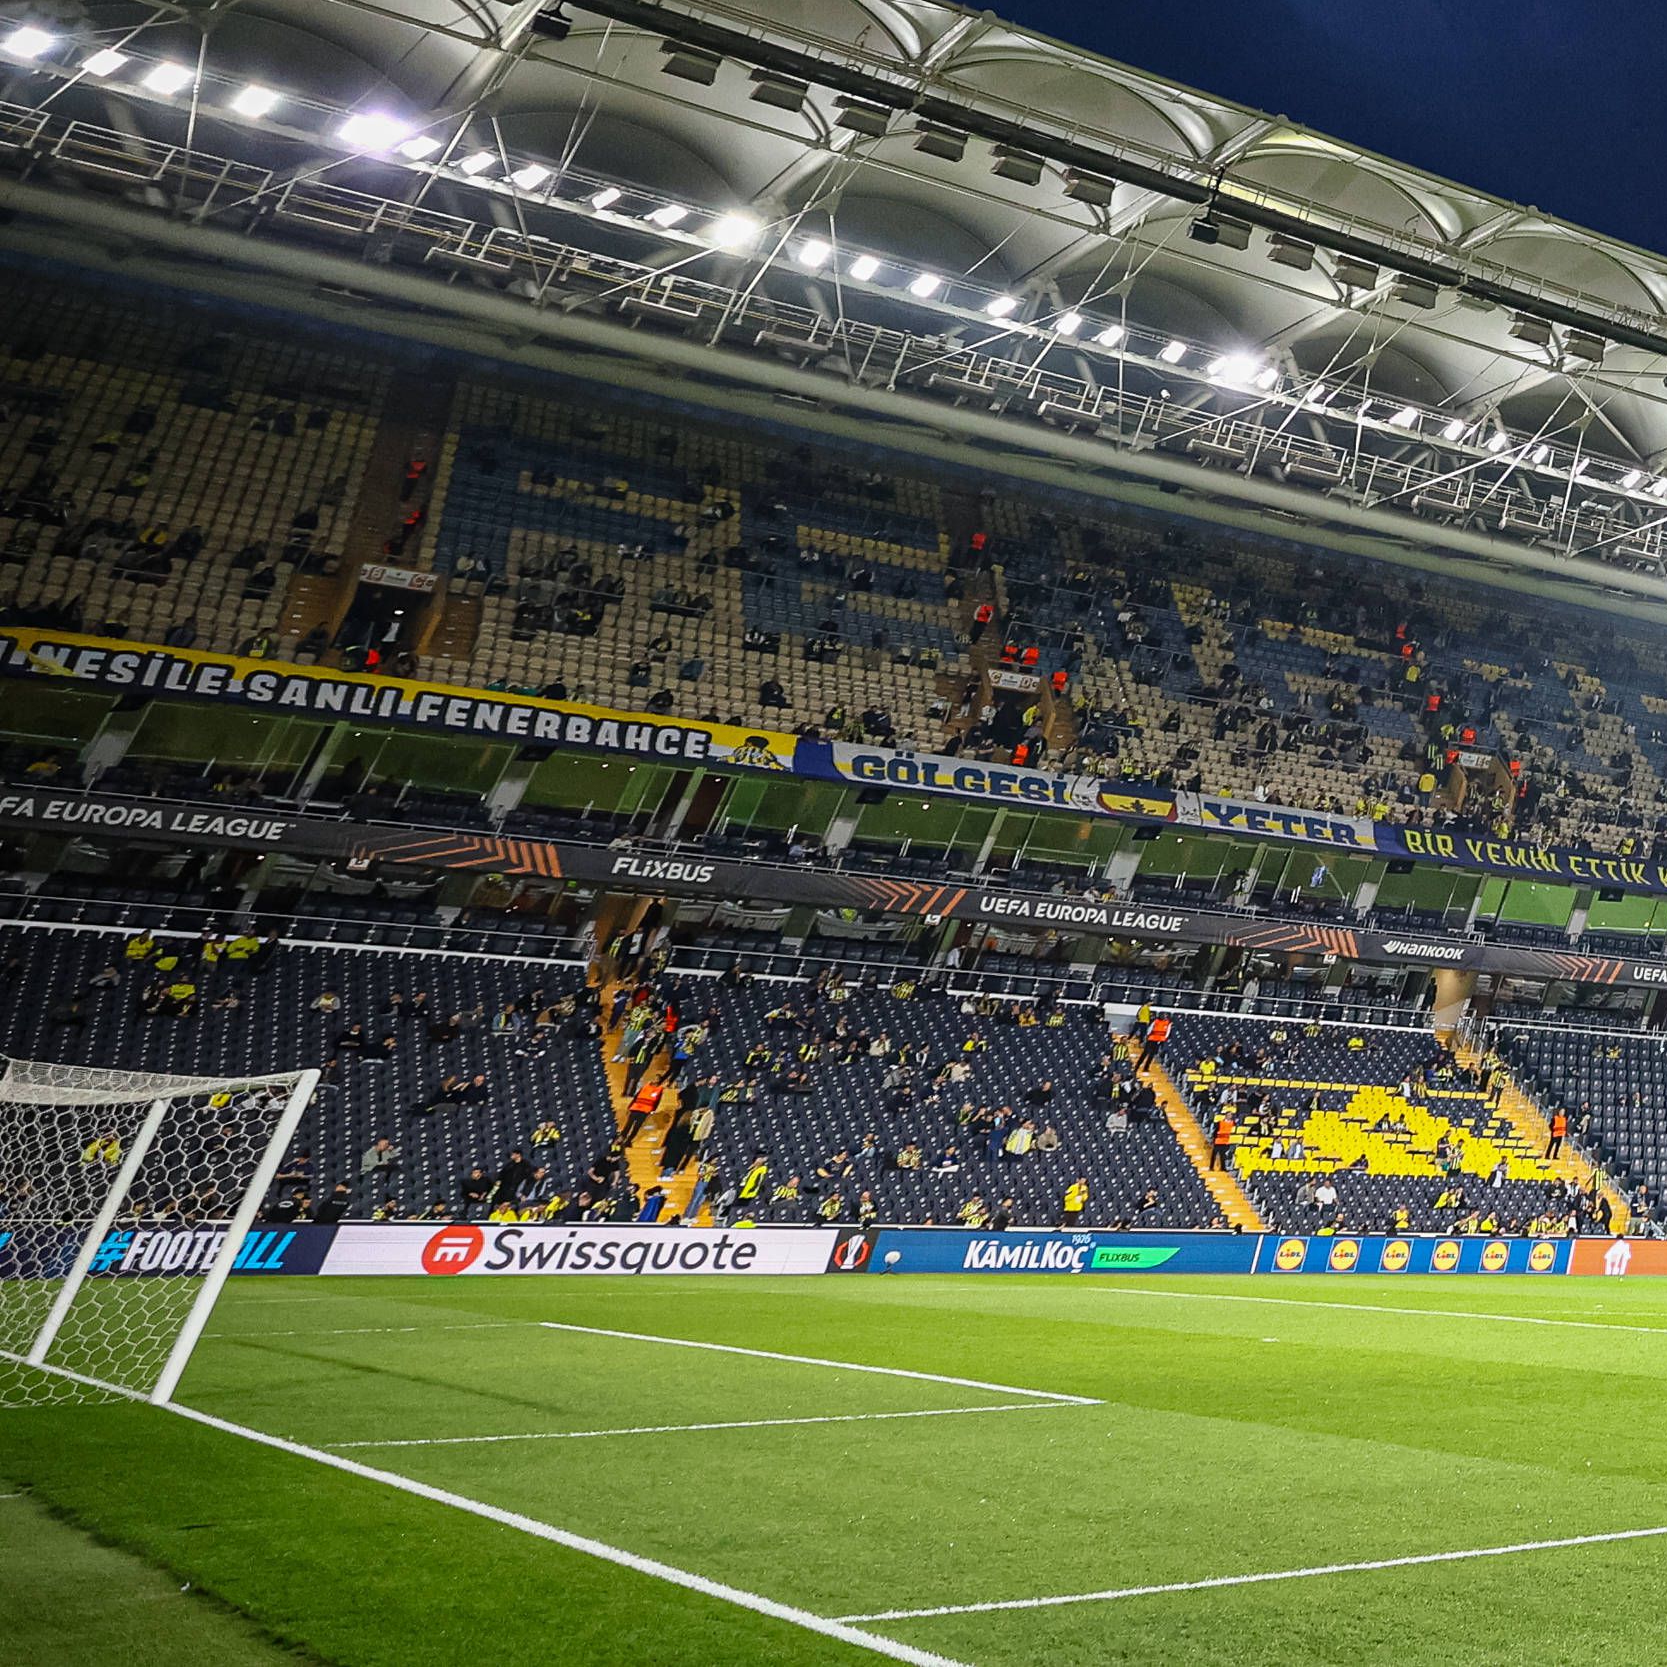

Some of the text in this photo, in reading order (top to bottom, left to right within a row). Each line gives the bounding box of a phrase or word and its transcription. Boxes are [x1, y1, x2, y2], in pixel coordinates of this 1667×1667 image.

[0, 795, 287, 841] FA EUROPA LEAGUE
[851, 749, 1372, 847] GÖLGESİ YETER
[1404, 829, 1459, 859] BİR
[1467, 839, 1561, 875] YEMİN
[980, 894, 1183, 932] UEFA EUROPA LEAGUE
[1633, 965, 1667, 983] UEFA
[484, 1229, 757, 1274] Swissquote
